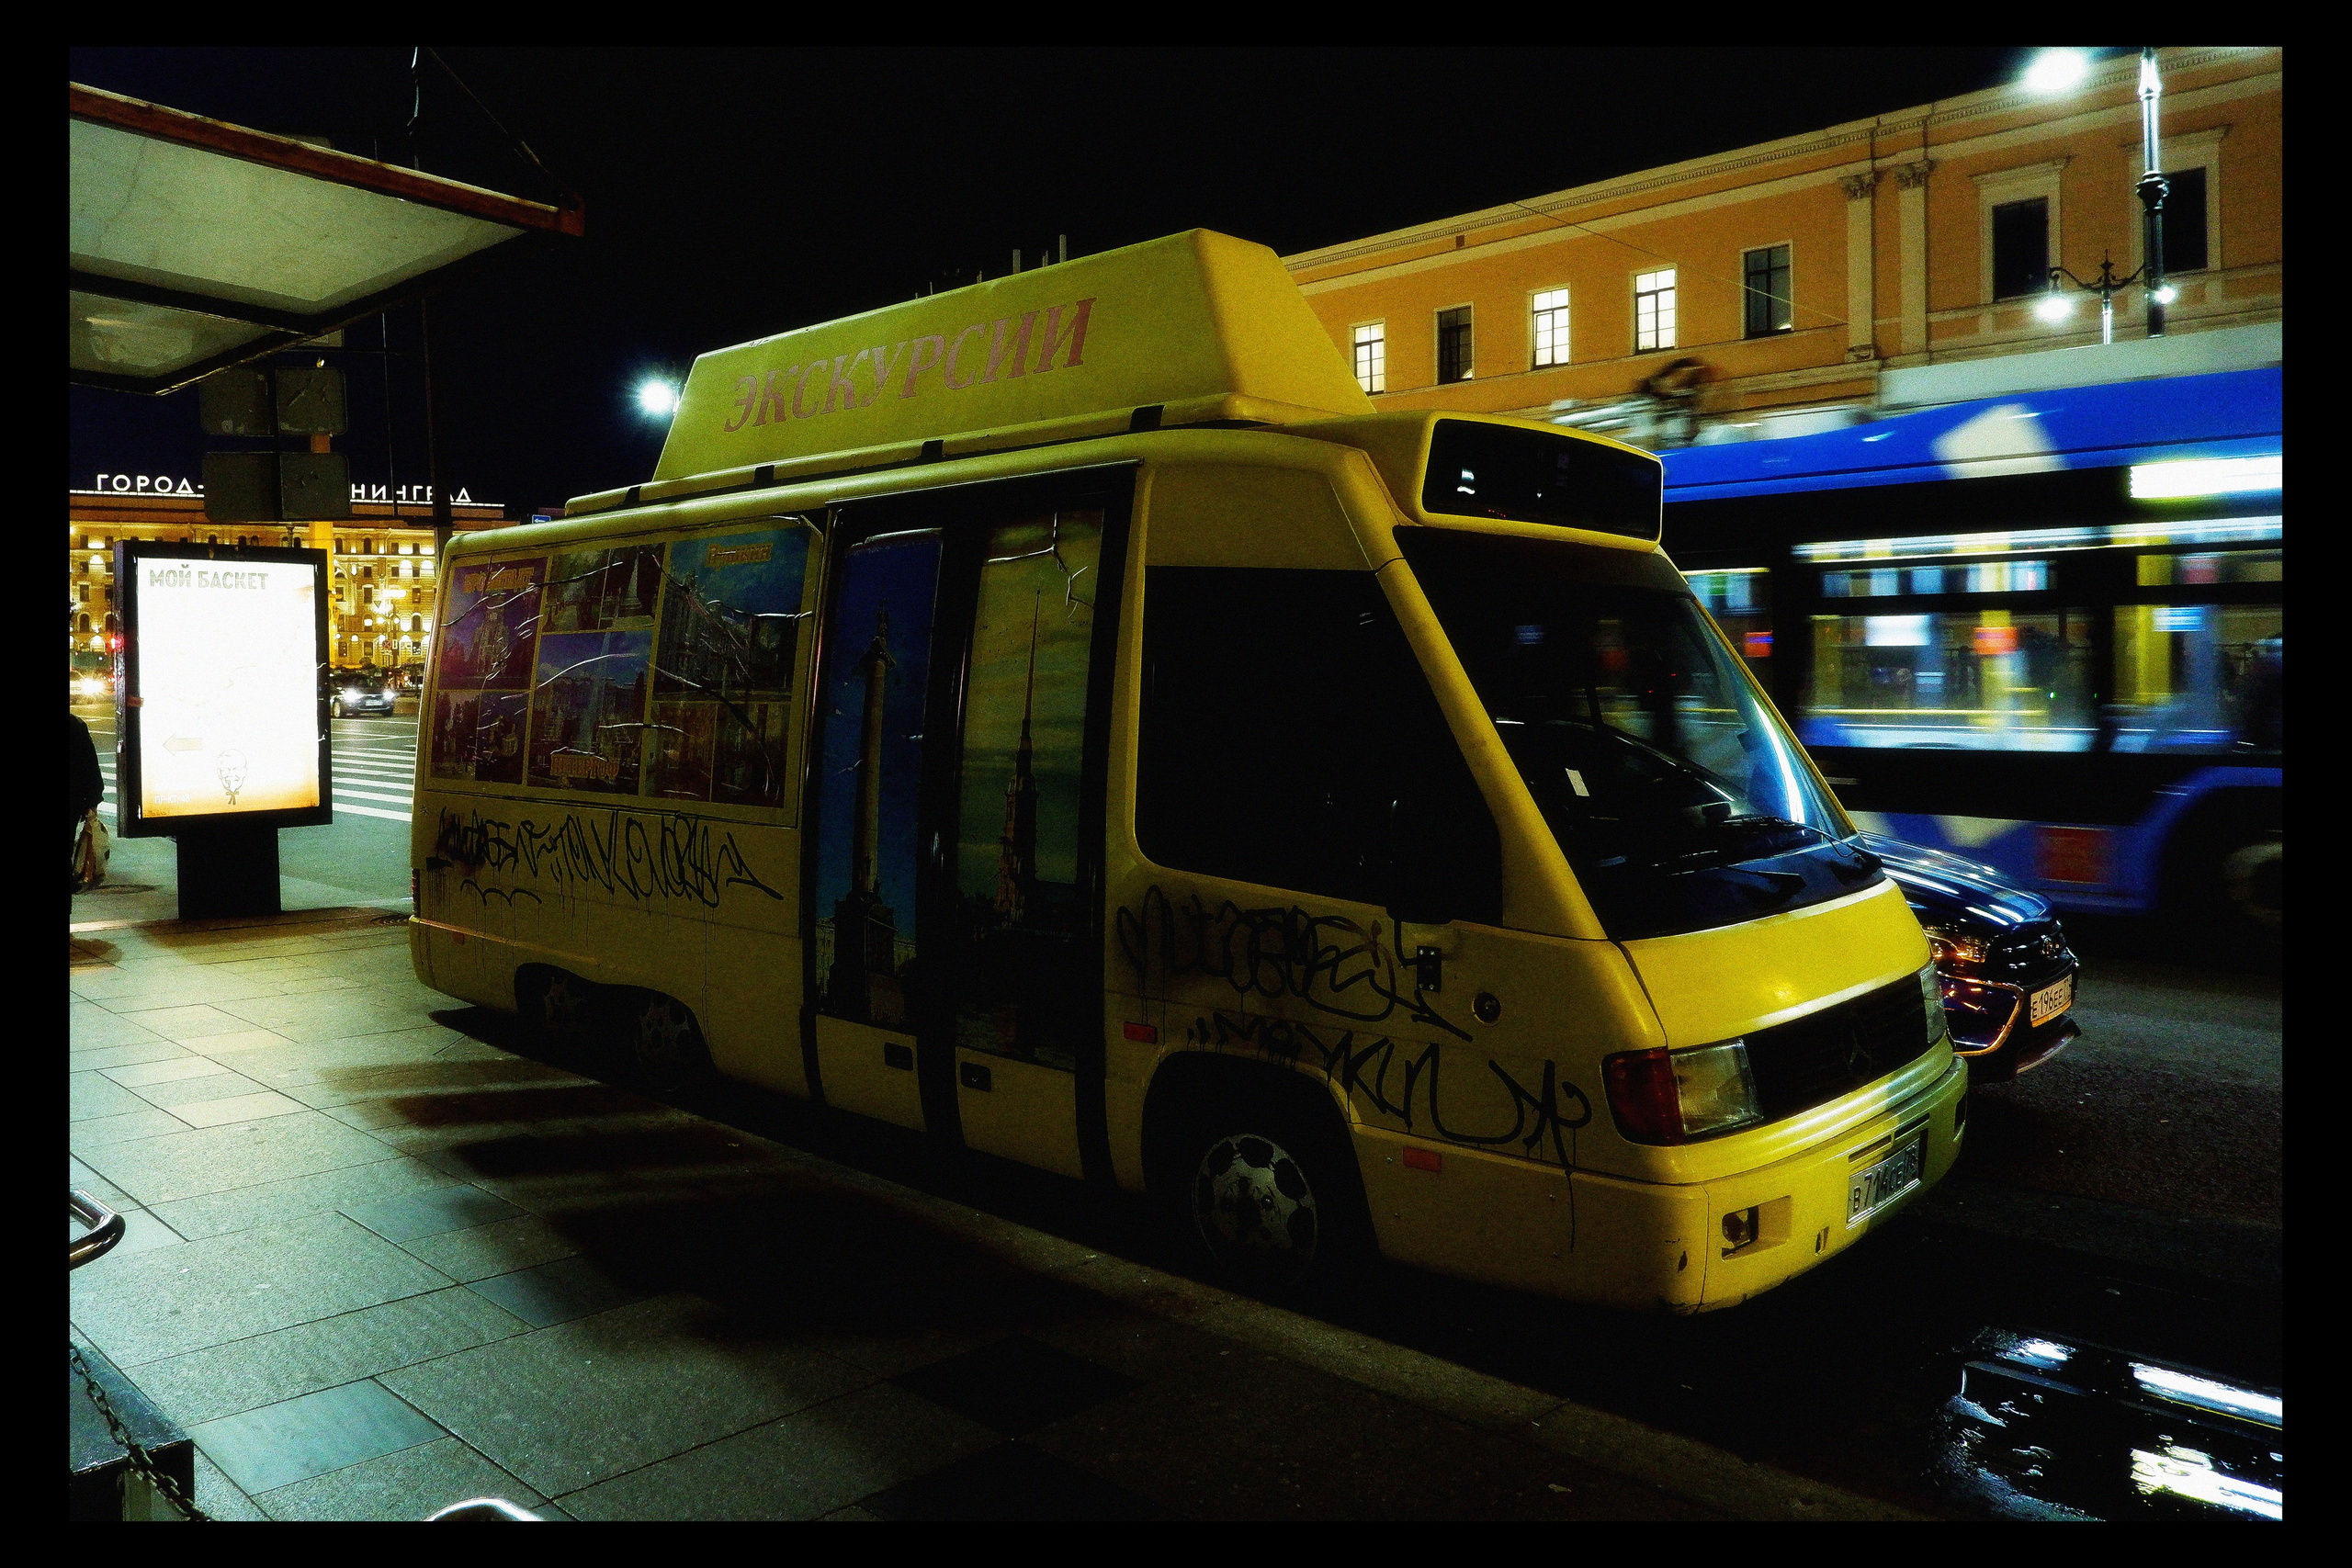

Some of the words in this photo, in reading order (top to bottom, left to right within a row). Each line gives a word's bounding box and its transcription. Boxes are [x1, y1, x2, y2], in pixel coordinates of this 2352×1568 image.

[724, 297, 1098, 433] ЭКСКУРСИИ
[149, 563, 192, 588] МОЙ
[198, 570, 268, 590] БАСКЕТ
